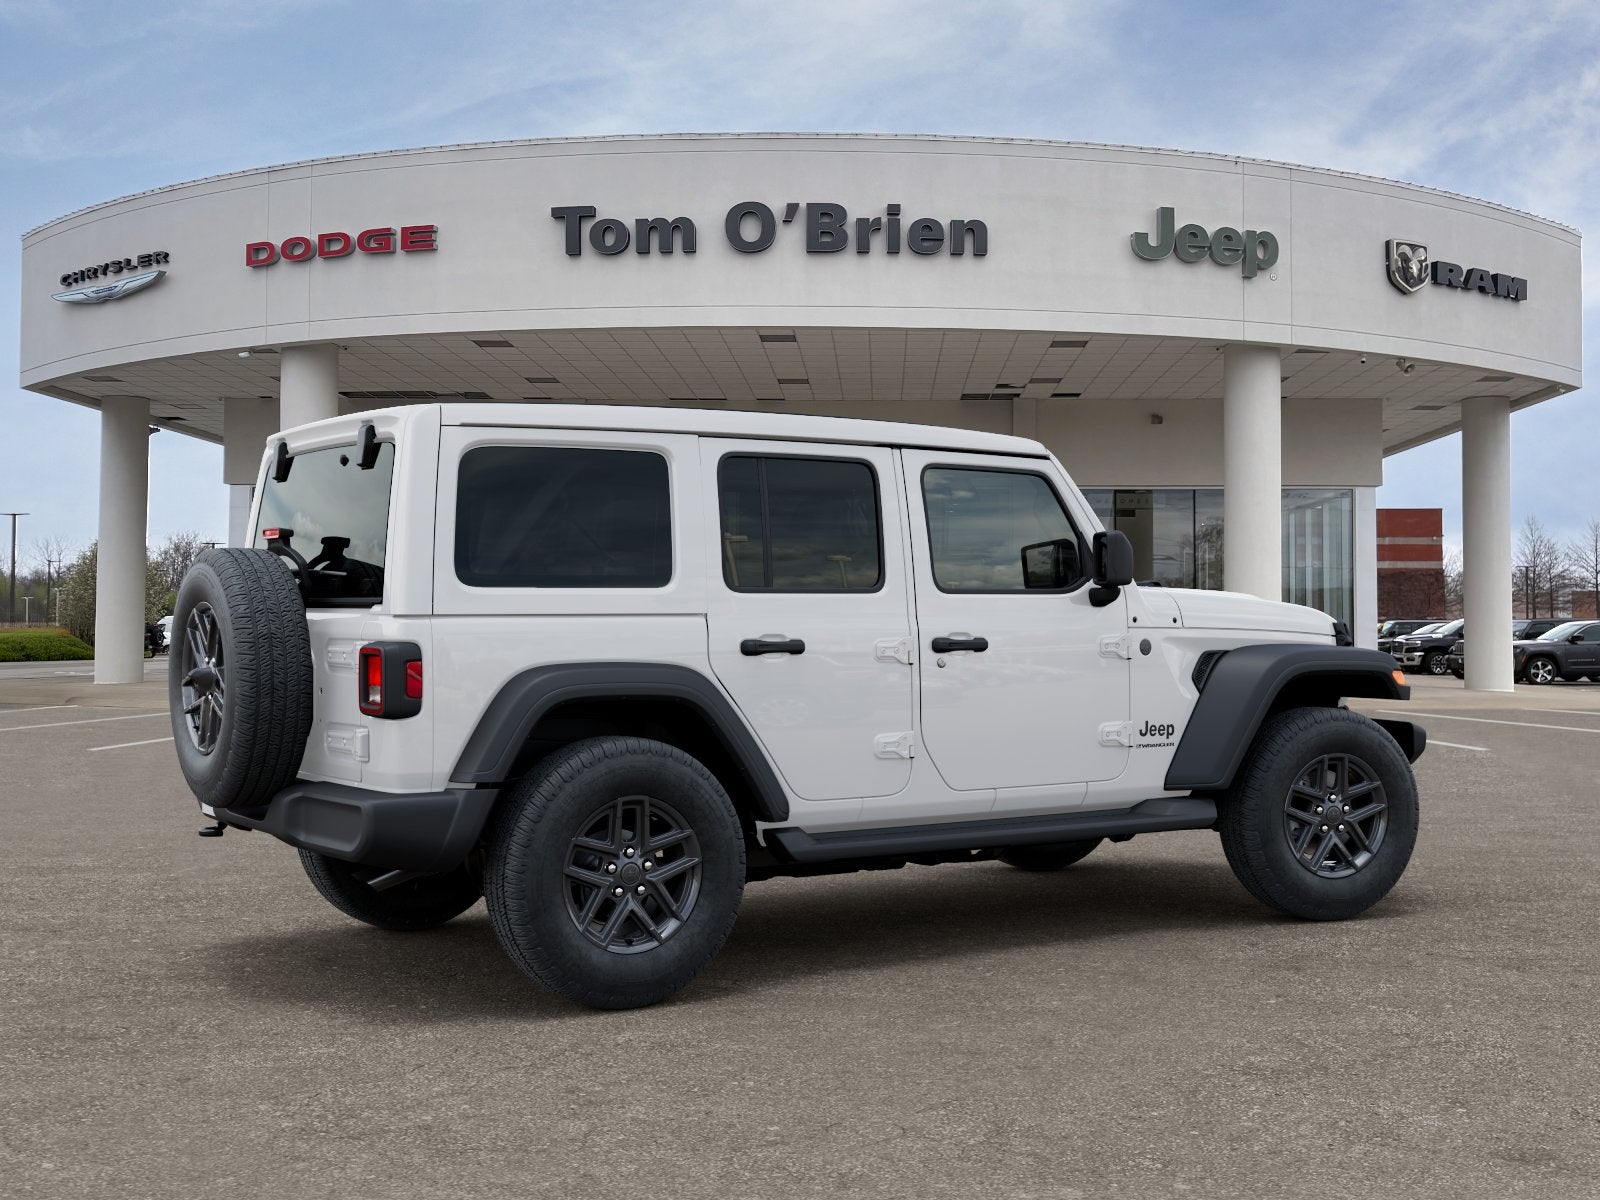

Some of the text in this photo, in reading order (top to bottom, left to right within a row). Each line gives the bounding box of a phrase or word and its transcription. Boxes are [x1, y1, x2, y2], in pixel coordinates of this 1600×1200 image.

[245, 224, 438, 269] DODGE
[551, 201, 988, 257] Tom O'Brien
[1131, 206, 1279, 279] Jeep
[60, 250, 170, 287] CHRYSLER
[1431, 260, 1528, 302] RAM
[1139, 720, 1175, 739] Jeep
